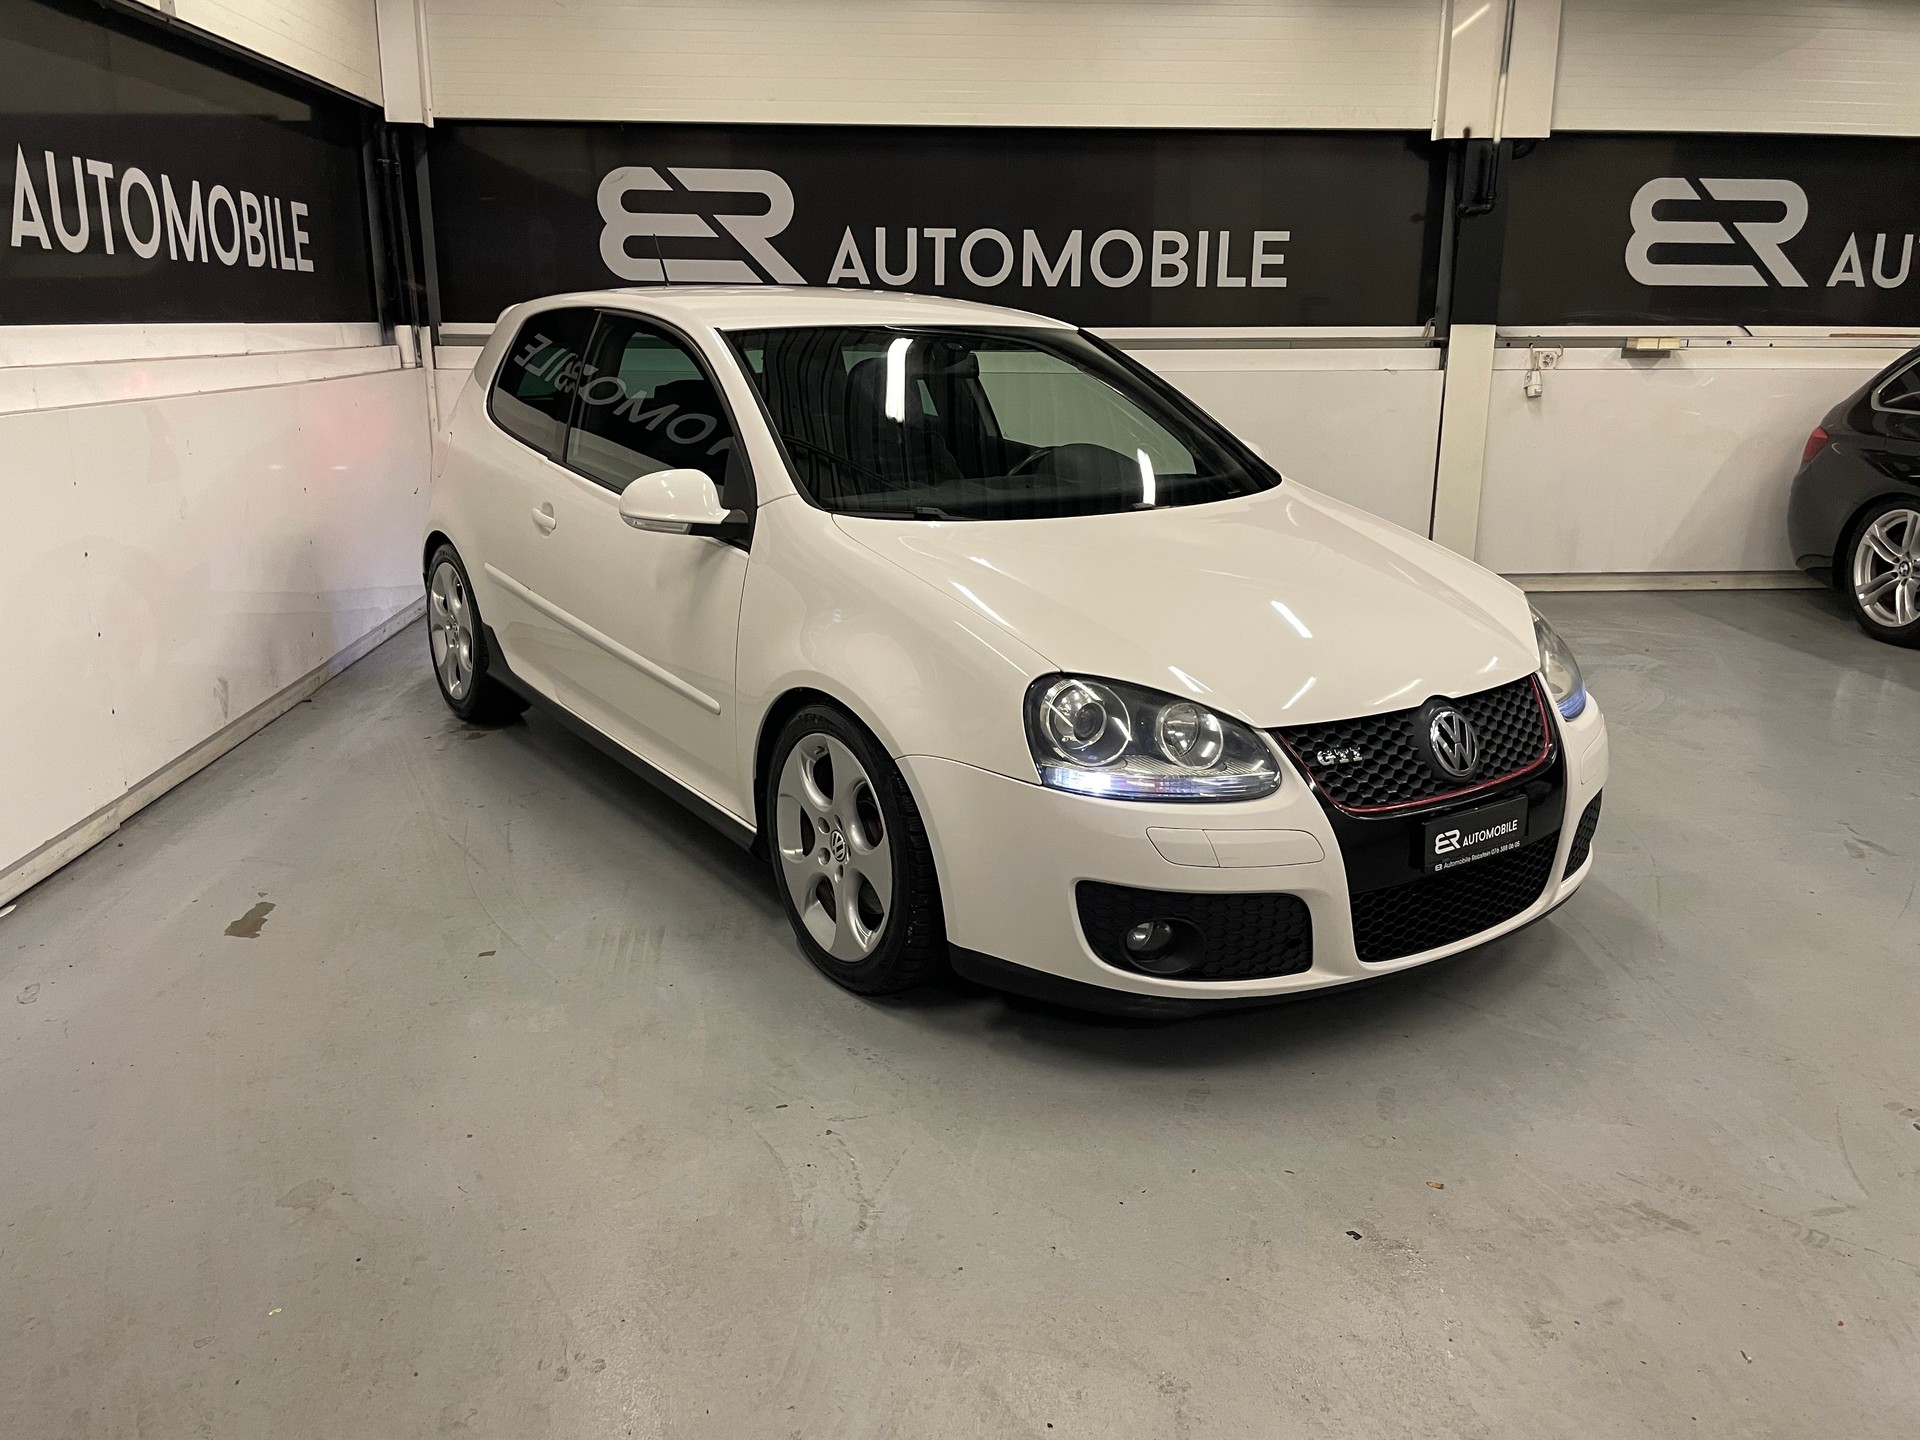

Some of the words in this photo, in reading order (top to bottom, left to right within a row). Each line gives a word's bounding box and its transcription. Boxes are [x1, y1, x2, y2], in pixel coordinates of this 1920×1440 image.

[11, 142, 315, 273] AUTOMOBILE
[827, 225, 1290, 289] AUTOMOBILE
[1825, 231, 1920, 289] AU
[1462, 819, 1519, 847] AUTOMOBILE
[1443, 856, 1471, 869] Automobile
